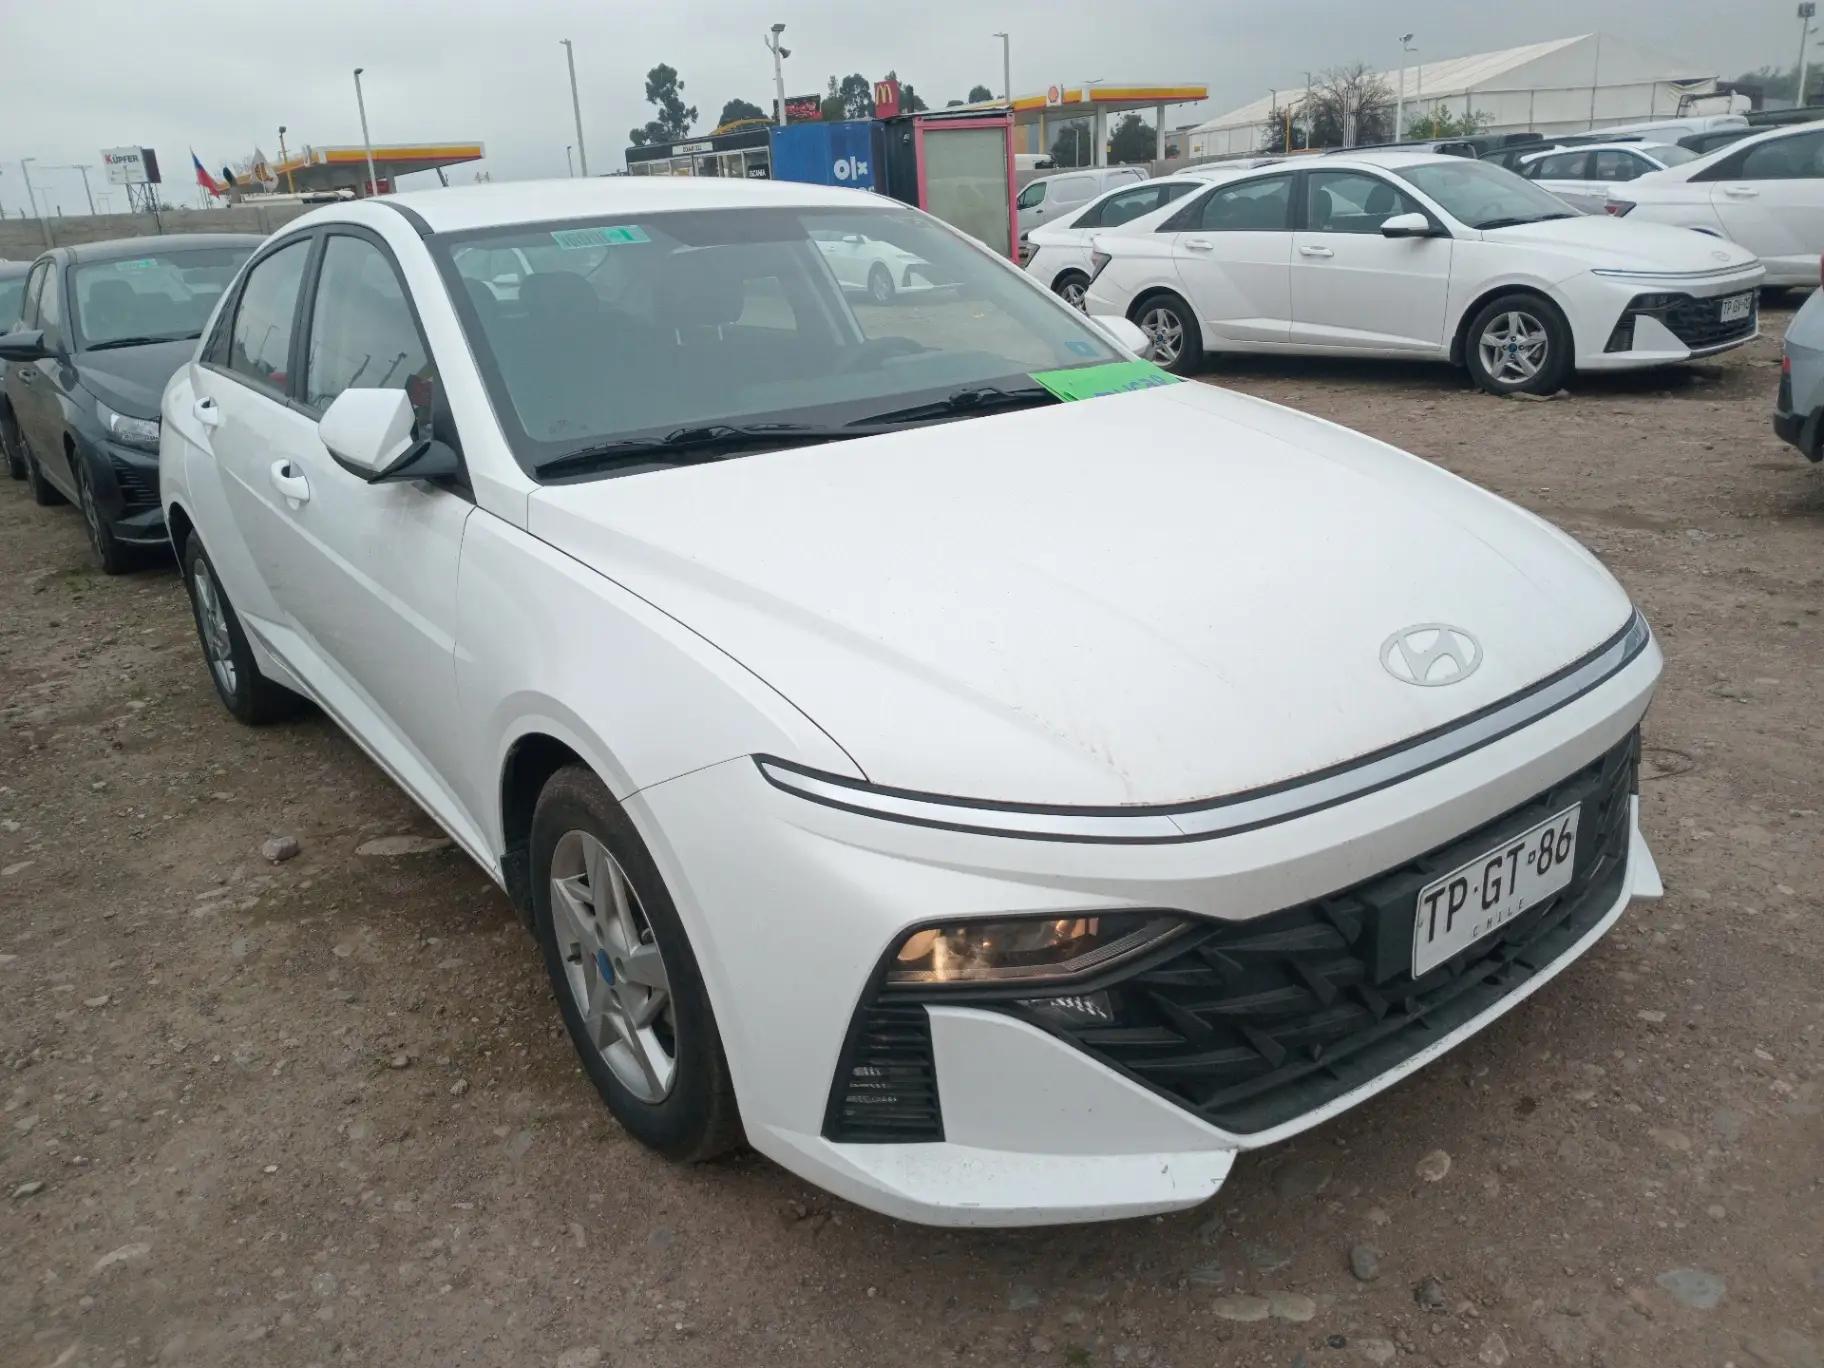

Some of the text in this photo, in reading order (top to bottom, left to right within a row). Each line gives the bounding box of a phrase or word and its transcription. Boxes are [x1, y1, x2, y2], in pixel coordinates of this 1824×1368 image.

[104, 154, 139, 164] KÜPFER
[833, 155, 868, 181] olx
[1472, 898, 1524, 938] CHILE
